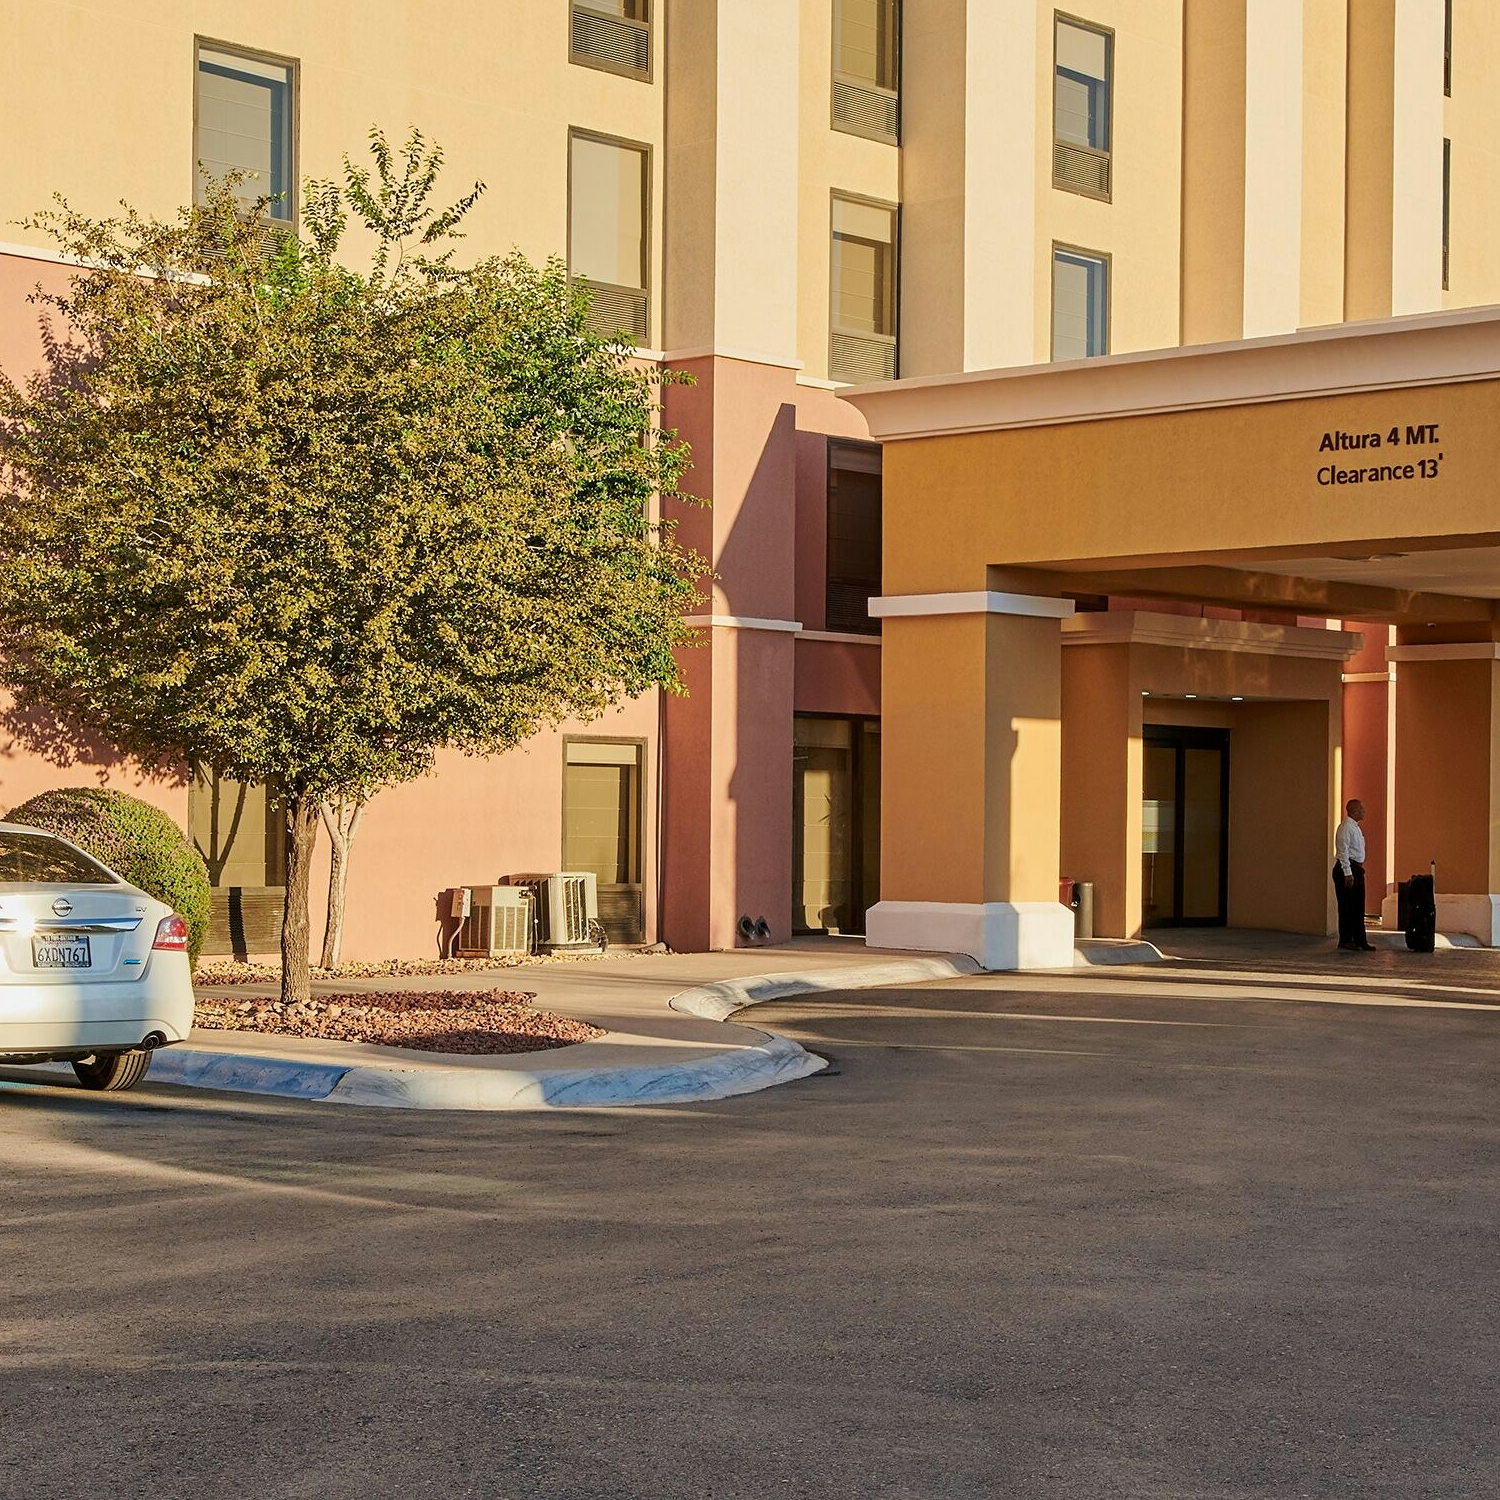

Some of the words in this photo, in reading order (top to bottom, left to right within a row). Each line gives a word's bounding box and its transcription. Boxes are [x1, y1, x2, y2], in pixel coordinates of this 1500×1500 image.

[1319, 431, 1381, 452] Altura
[1387, 427, 1400, 446] 4
[1406, 424, 1439, 445] MT.
[1317, 465, 1415, 485] Clearance
[37, 947, 86, 962] 6XDN767
